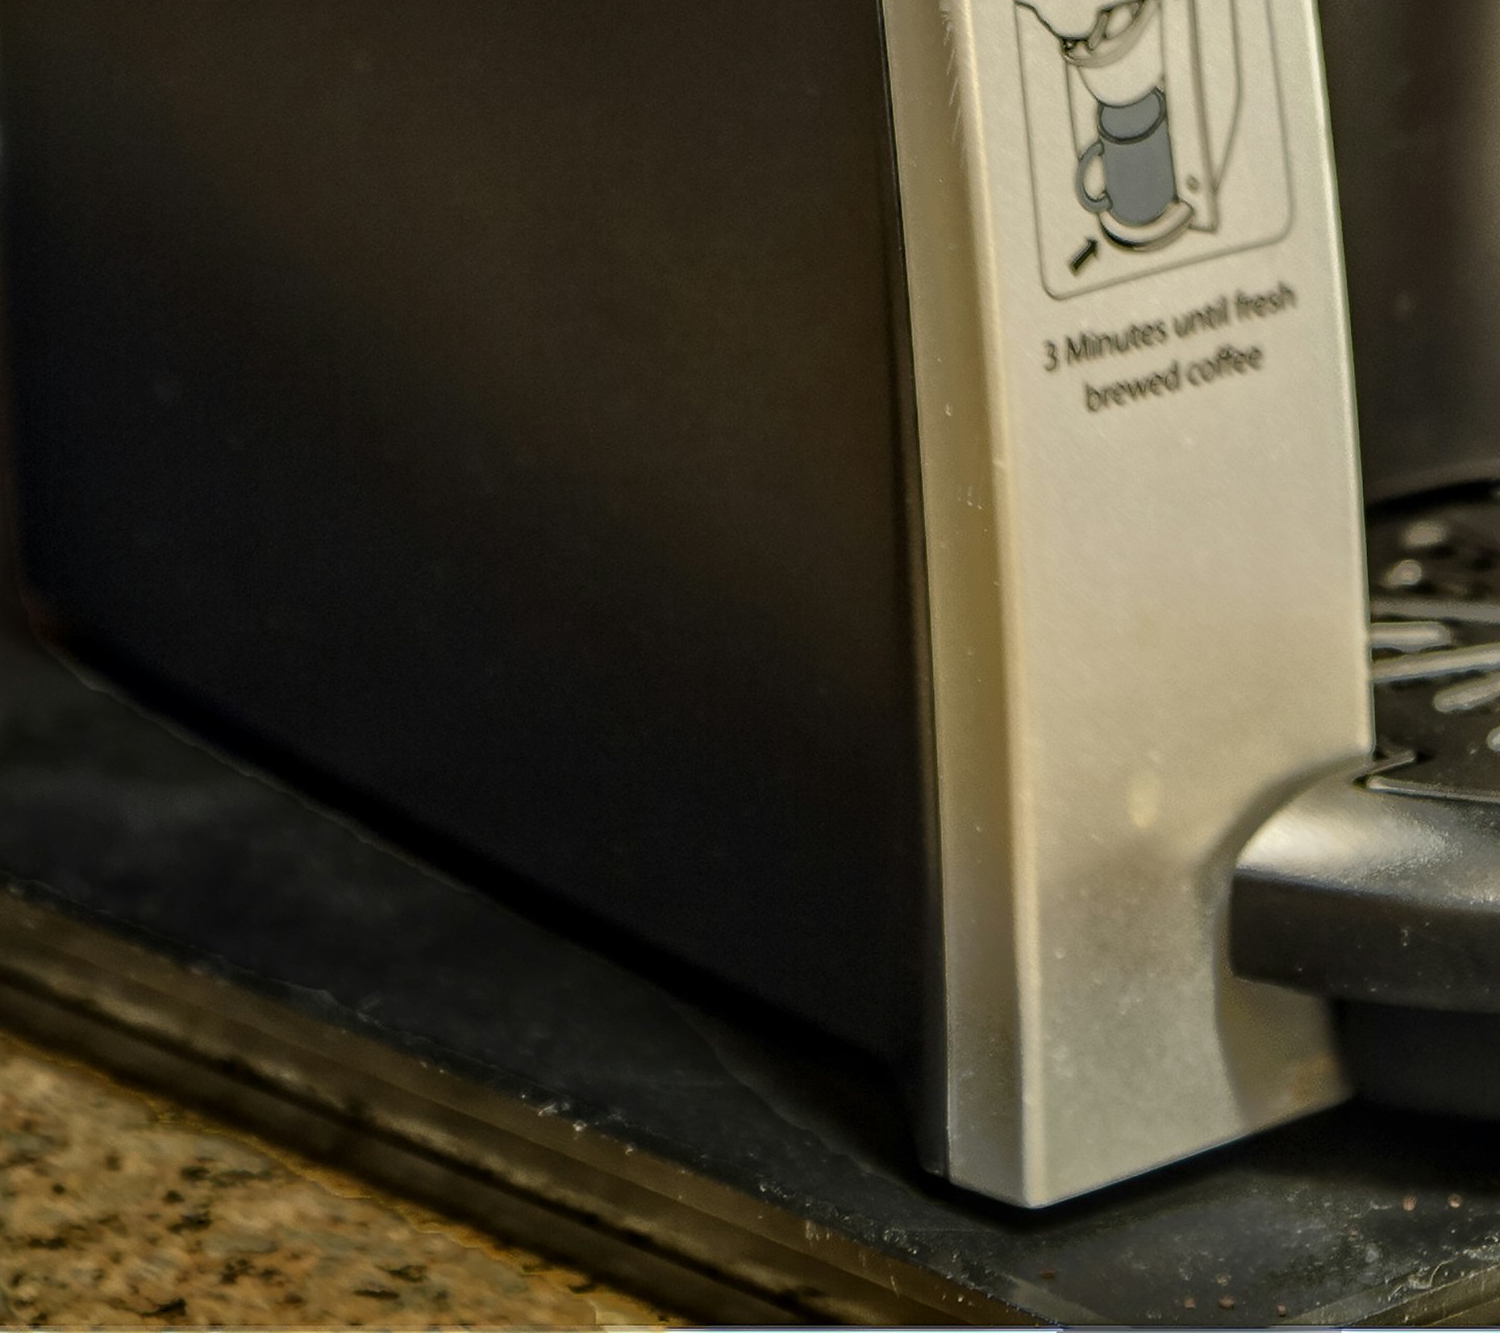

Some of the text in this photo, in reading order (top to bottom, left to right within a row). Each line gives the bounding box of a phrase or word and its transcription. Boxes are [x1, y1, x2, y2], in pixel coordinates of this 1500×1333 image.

[1043, 281, 1298, 373] 3 Minutes until fresh
[1083, 342, 1266, 414] brewed coffee
